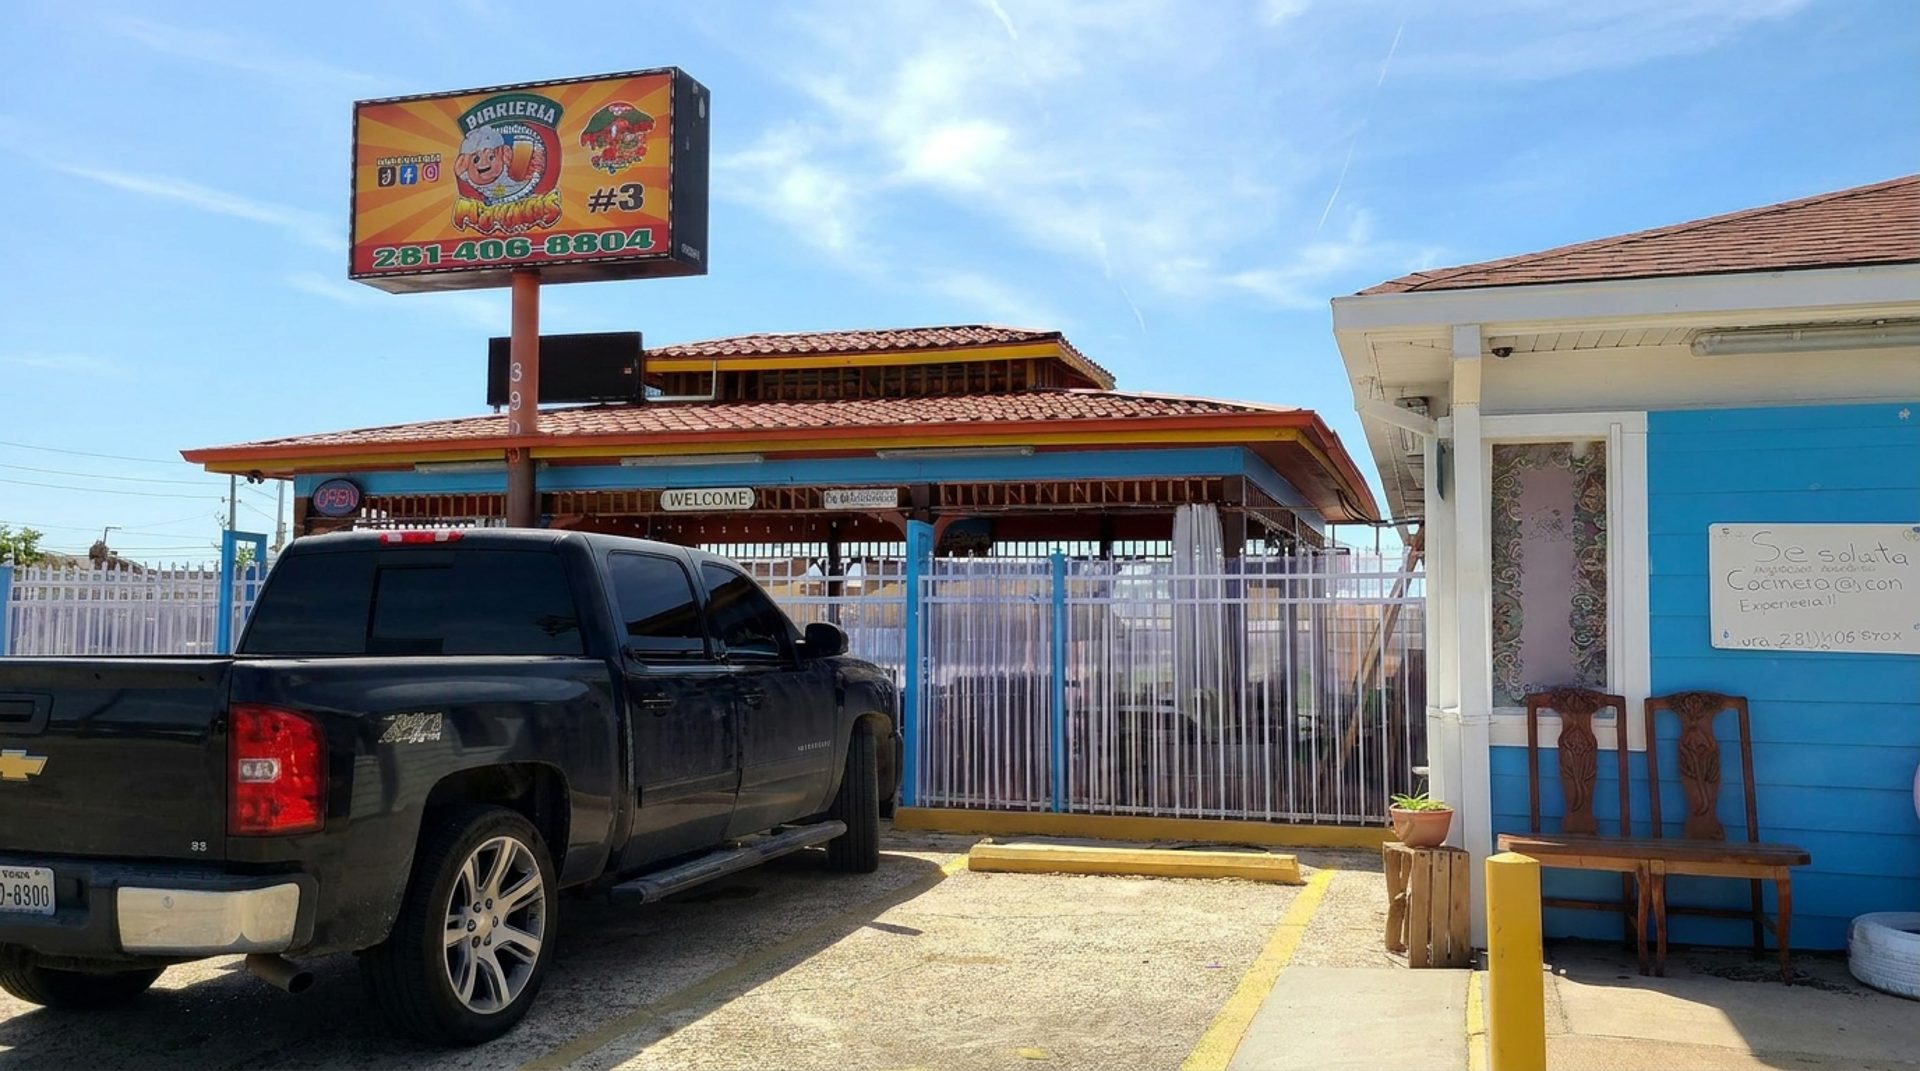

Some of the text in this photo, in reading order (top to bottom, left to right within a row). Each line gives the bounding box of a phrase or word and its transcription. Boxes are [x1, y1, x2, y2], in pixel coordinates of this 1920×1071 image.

[588, 183, 645, 214] #3
[669, 491, 748, 507] WELCOME
[1752, 531, 1809, 563] Se
[1865, 578, 1903, 590] con
